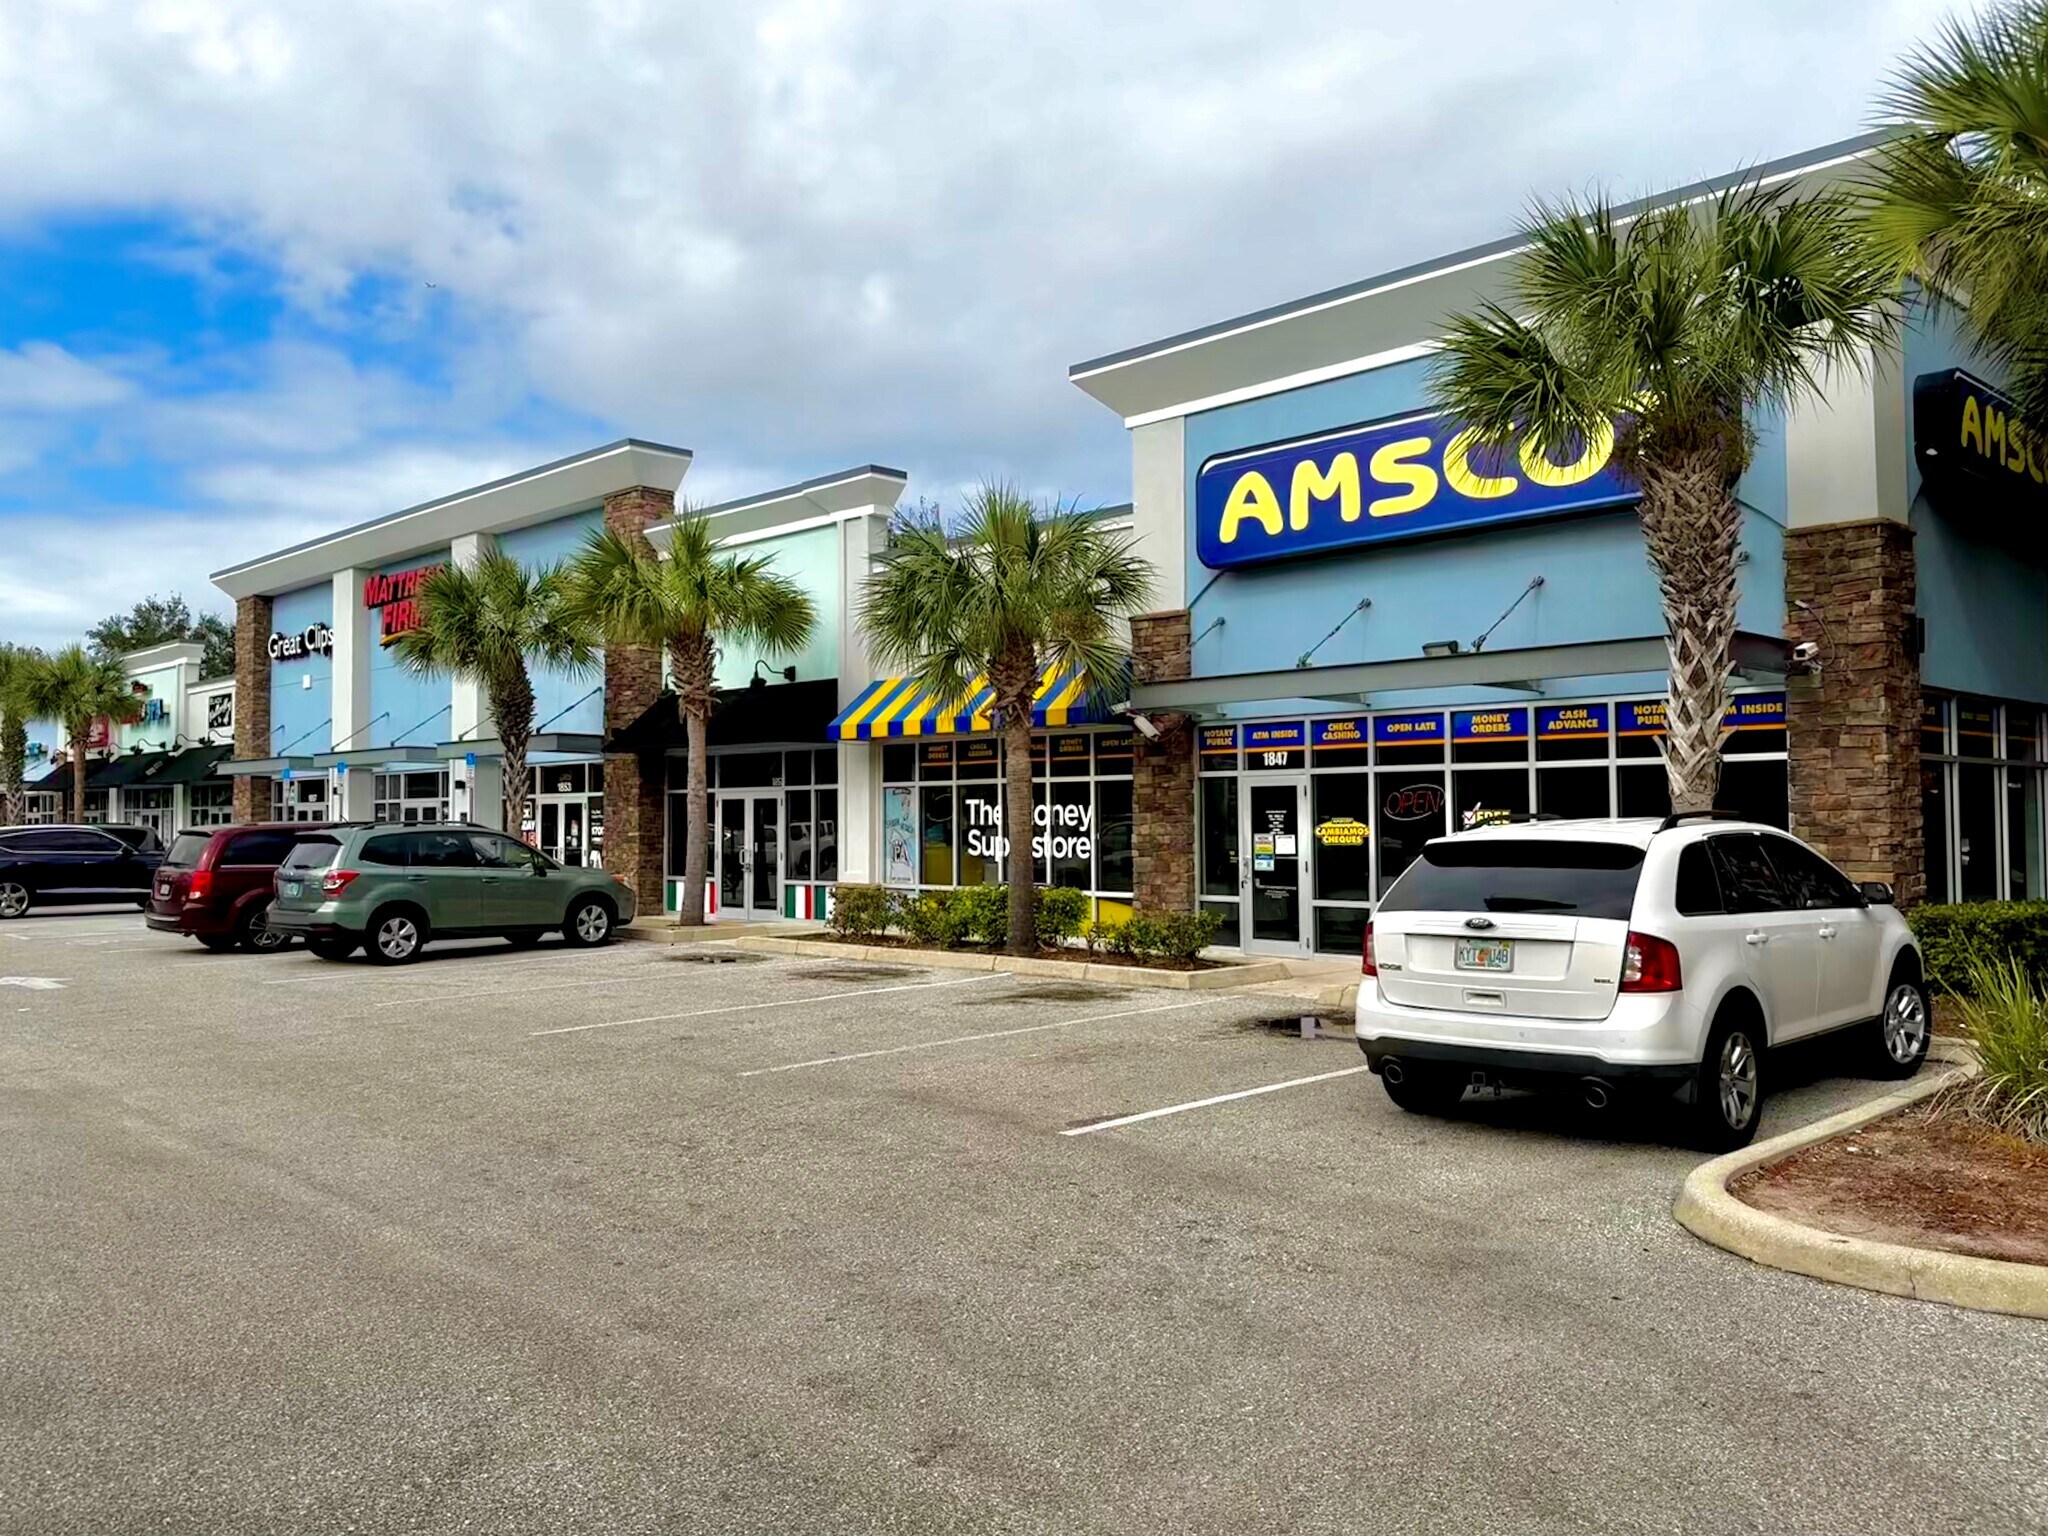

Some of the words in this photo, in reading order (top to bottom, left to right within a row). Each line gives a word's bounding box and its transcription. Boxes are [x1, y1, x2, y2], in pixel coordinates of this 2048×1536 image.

[1961, 395, 2048, 485] AMSC
[267, 634, 302, 658] Great
[305, 624, 335, 655] Clips
[1559, 709, 1587, 719] CASH
[1633, 704, 1666, 715] NOTA
[1741, 703, 1783, 714] INSIDE
[1471, 713, 1509, 724] MONEY
[1637, 715, 1667, 725] PUBL
[1328, 721, 1355, 731] CHECK
[1387, 723, 1412, 733] OPEN
[1415, 721, 1437, 731] LATE
[1471, 723, 1511, 733] ORDERS
[1547, 719, 1598, 730] ADVANCE
[1204, 728, 1234, 738] NOTARY
[1252, 731, 1269, 740] ATM
[1271, 729, 1298, 738] INSIDE
[1322, 730, 1361, 740] CASHING
[1206, 737, 1233, 746] PUBLIC
[1263, 752, 1288, 766] 1847
[1387, 790, 1441, 814] OPEN
[965, 799, 1001, 826] The
[1031, 798, 1092, 832] oney
[1315, 827, 1370, 836] CAMBIAMOS
[1323, 835, 1361, 844] CHEQUES
[967, 829, 1091, 862] Supstore
